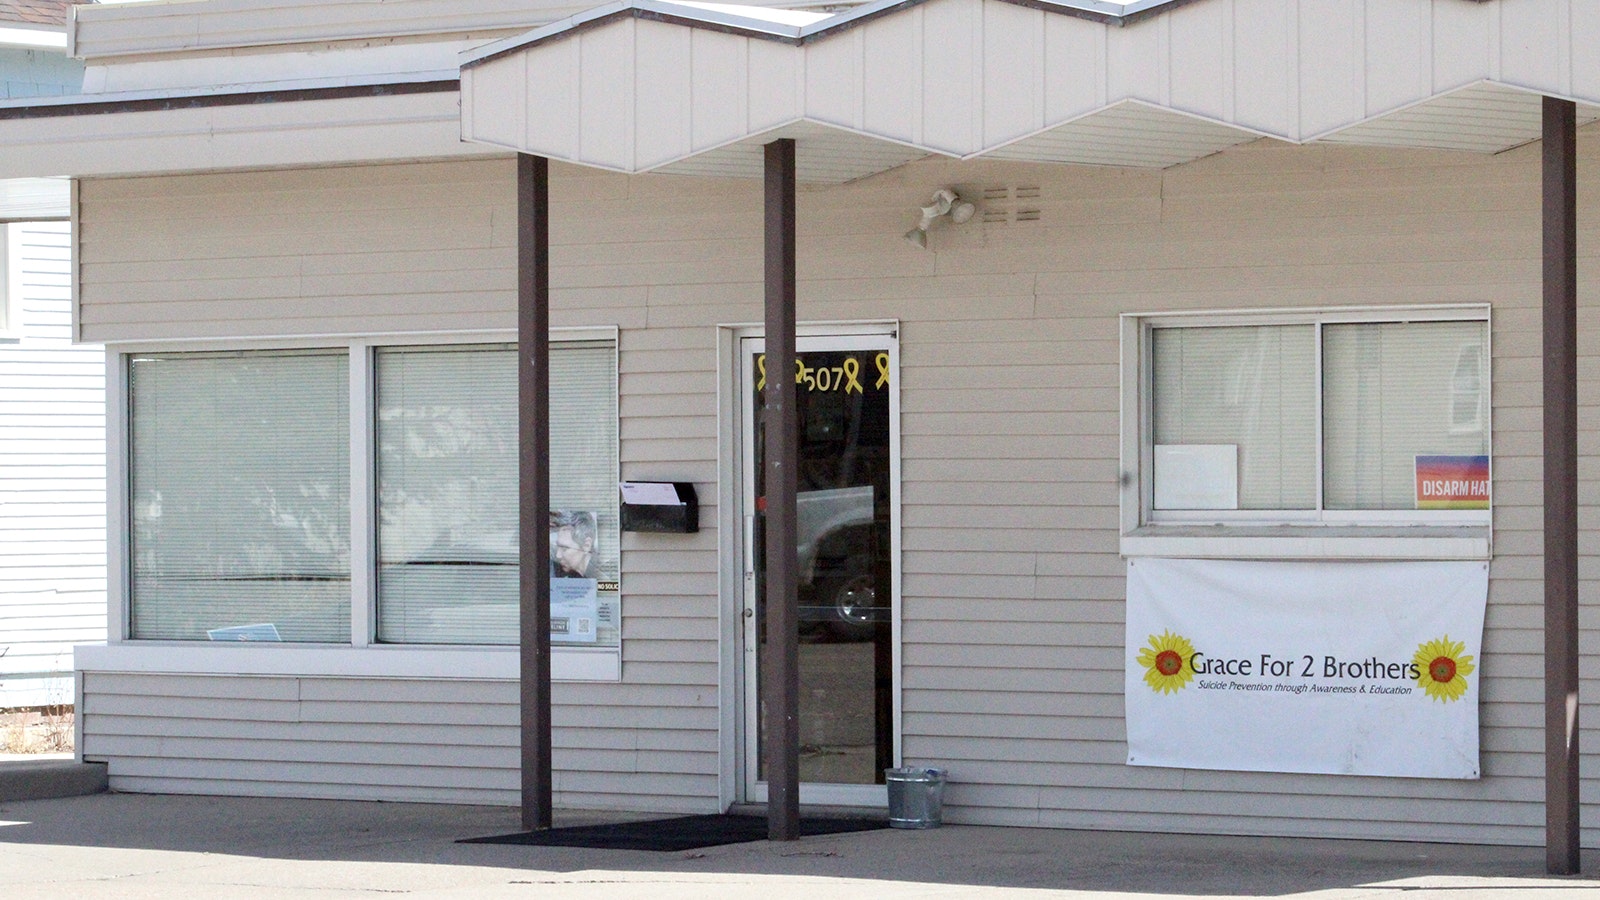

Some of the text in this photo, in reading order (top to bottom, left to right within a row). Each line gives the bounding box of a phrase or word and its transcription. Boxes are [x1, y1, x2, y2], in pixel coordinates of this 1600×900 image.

[803, 367, 844, 392] 507
[1423, 480, 1469, 496] DISARM
[1190, 652, 1421, 680] Grace For 2 Brothers
[1198, 680, 1412, 695] Suicide Prevention through Awareness & Education
